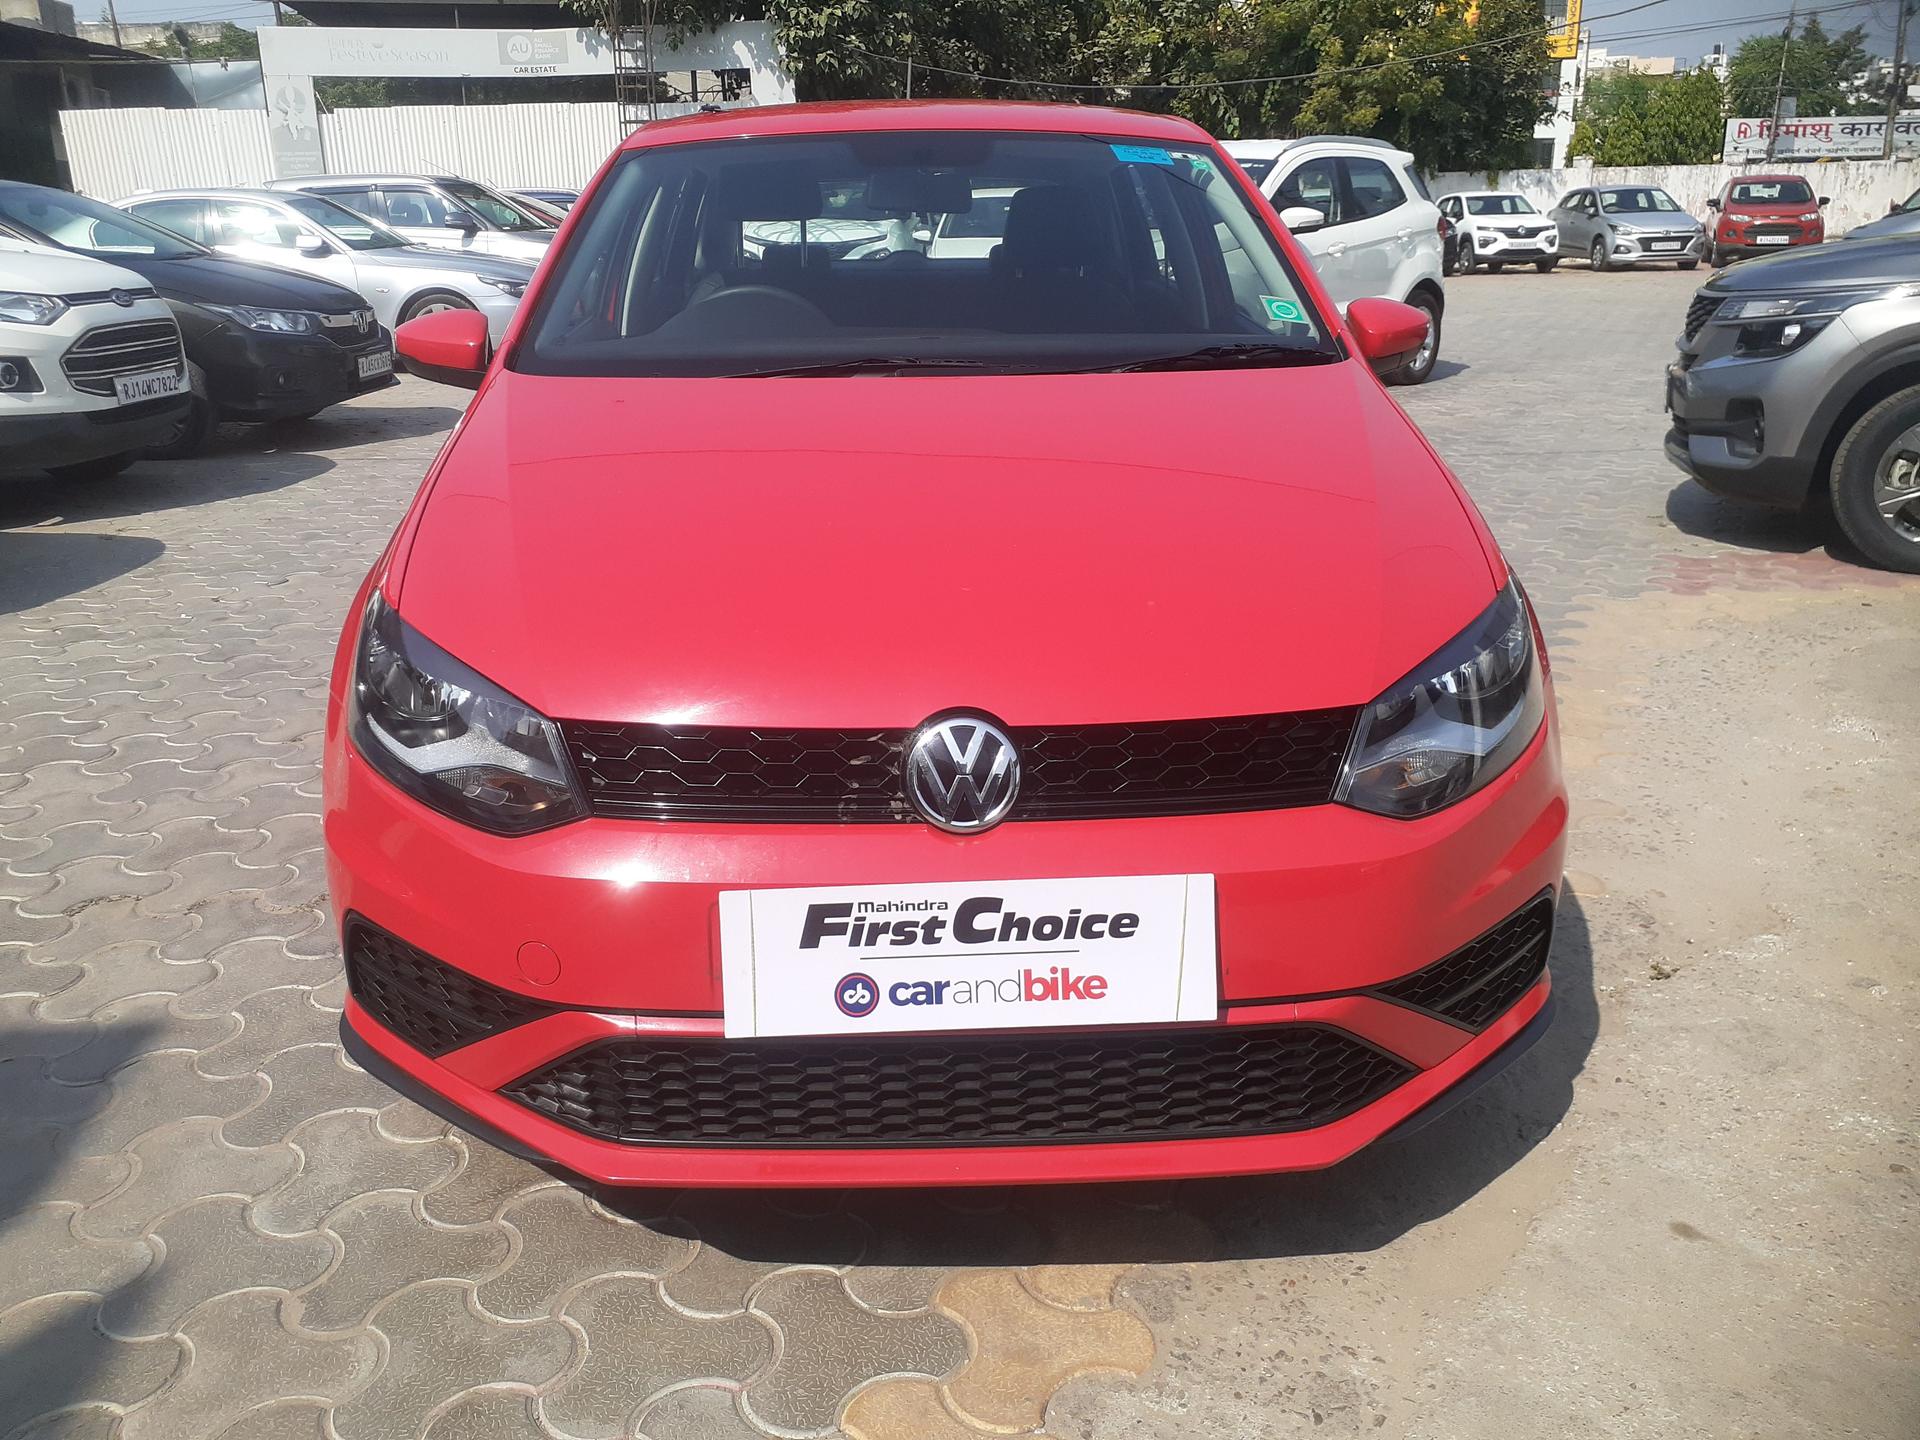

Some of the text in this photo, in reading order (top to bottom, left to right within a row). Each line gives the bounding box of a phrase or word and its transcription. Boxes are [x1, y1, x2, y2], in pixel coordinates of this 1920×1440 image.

[510, 43, 529, 54] AU
[513, 65, 558, 74] CAR ESTATE
[857, 899, 949, 914] Mahindra
[799, 896, 1140, 950] First Choice
